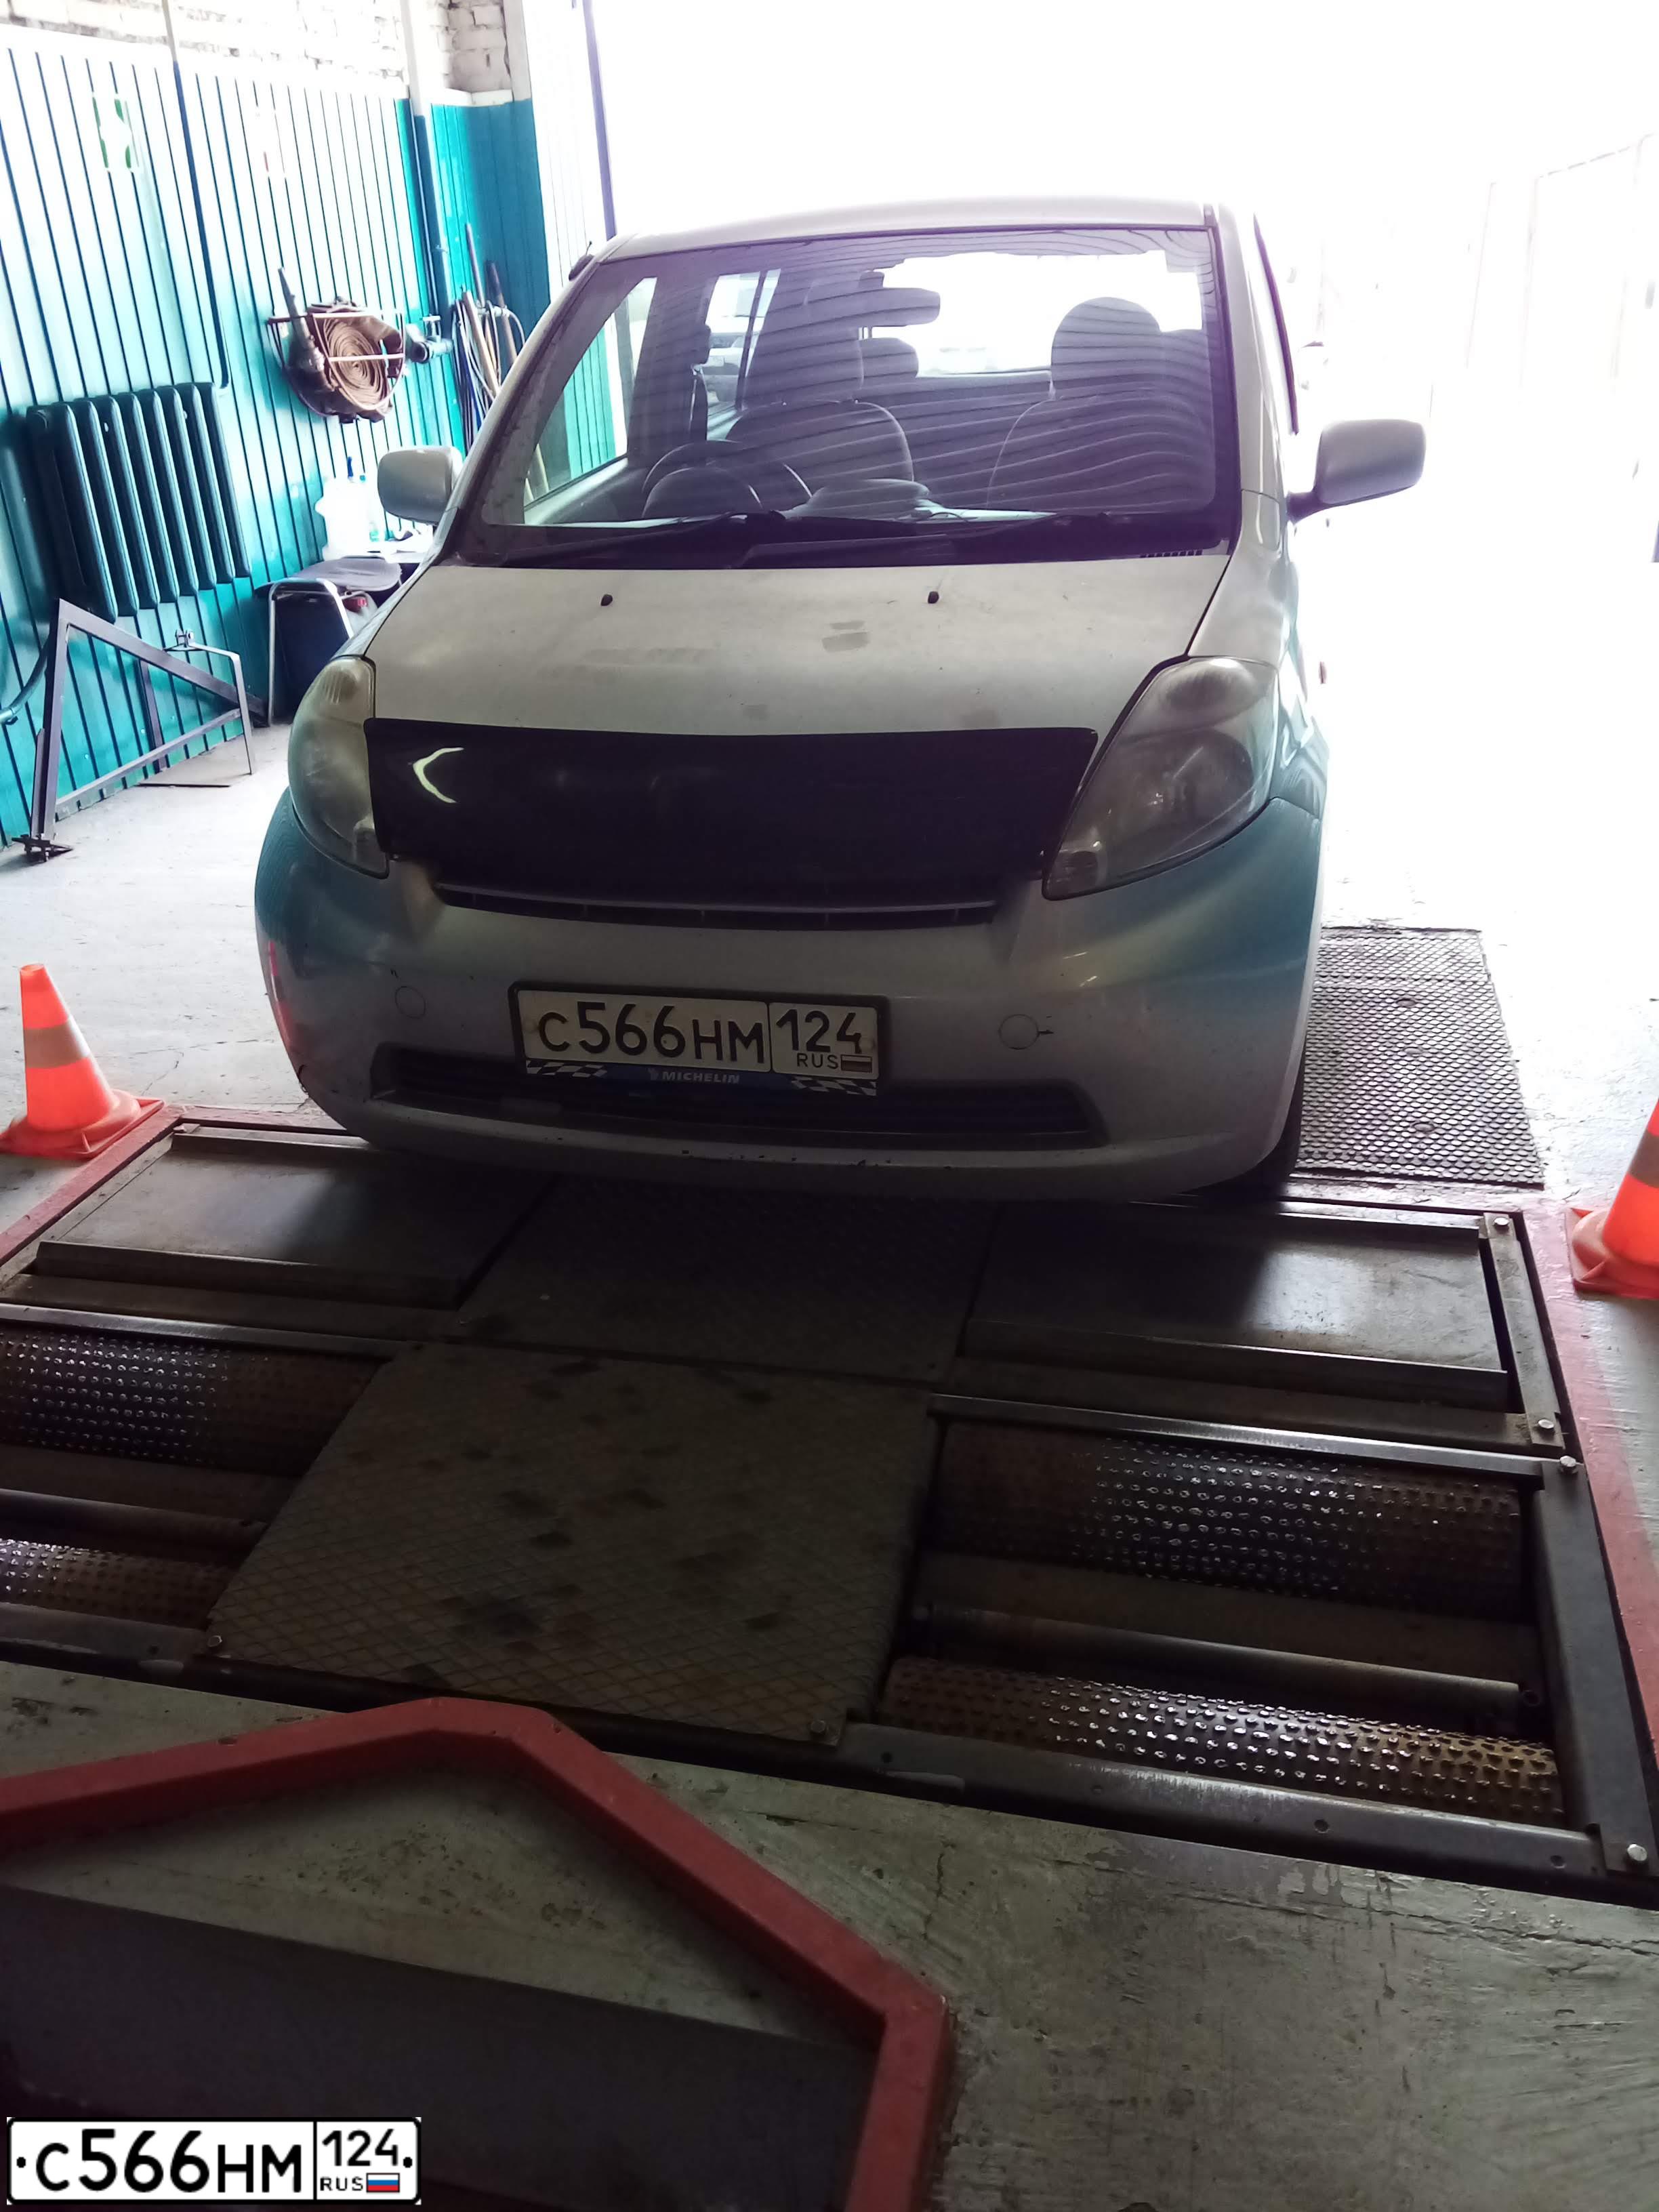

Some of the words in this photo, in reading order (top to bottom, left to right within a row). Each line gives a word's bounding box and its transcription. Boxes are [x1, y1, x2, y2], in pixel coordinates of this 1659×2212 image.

[776, 1009, 862, 1054] 124
[796, 1052, 838, 1069] RUS
[661, 1071, 740, 1084] MICHELIN
